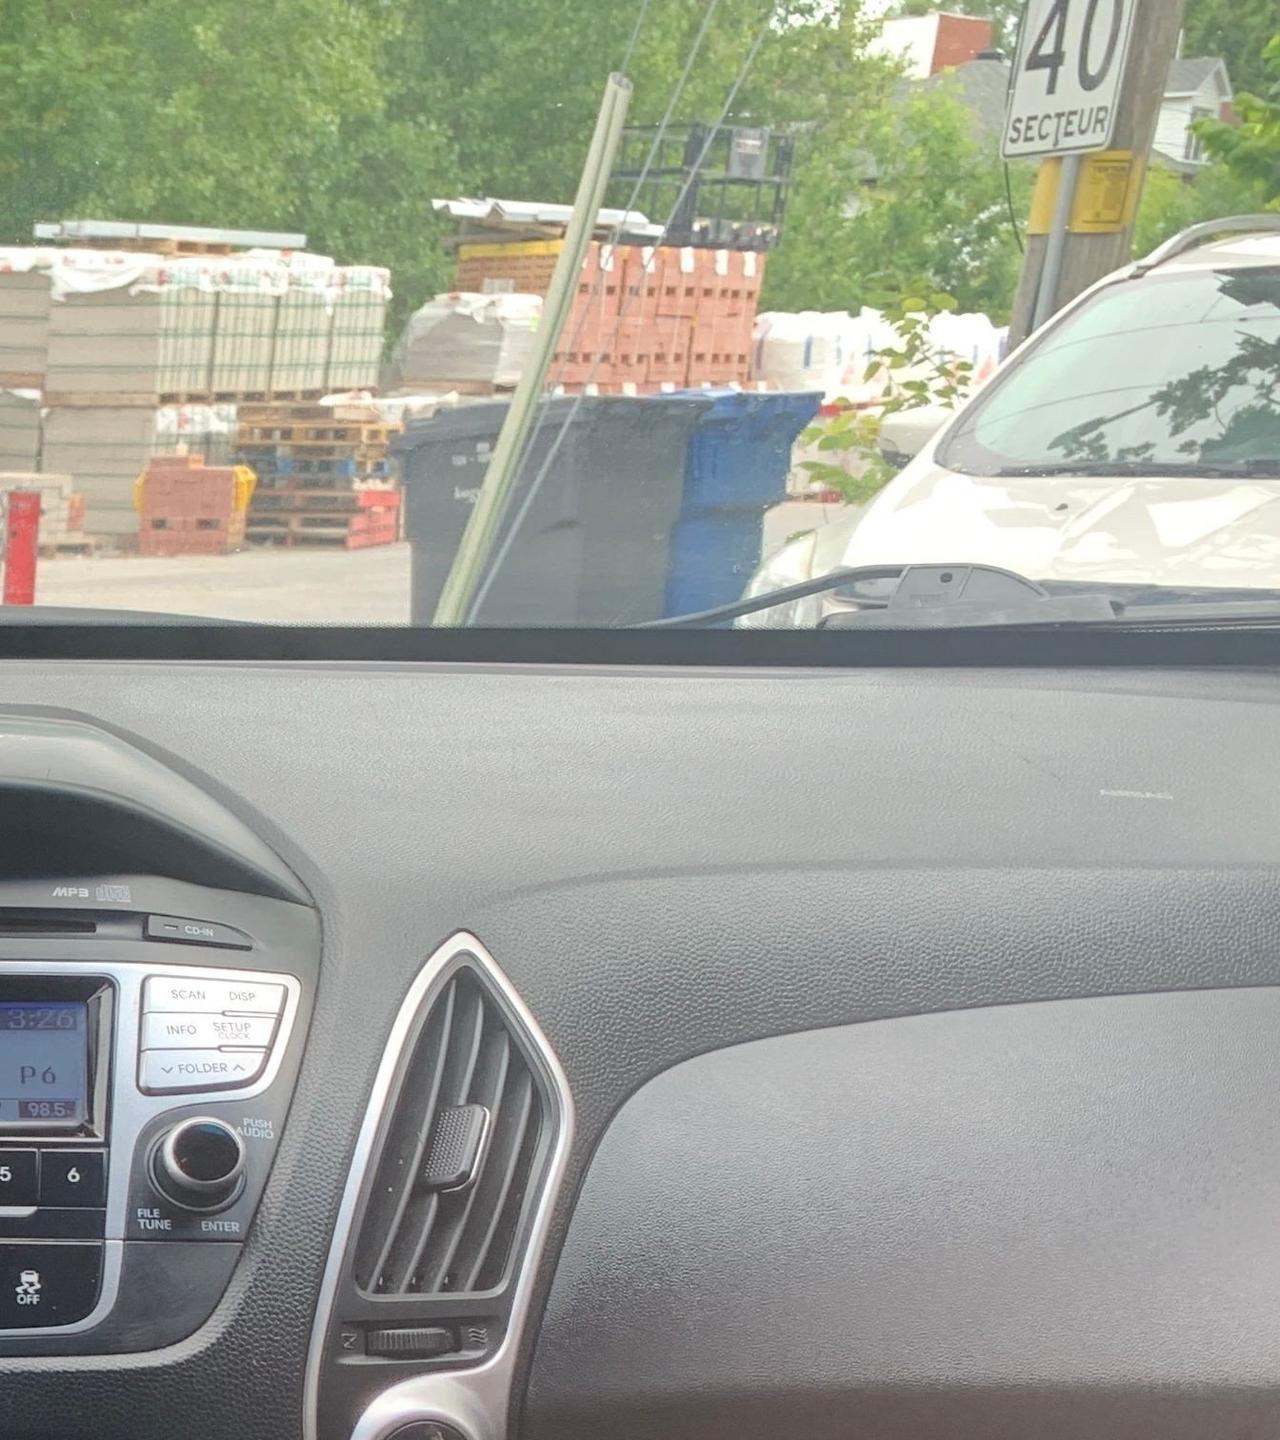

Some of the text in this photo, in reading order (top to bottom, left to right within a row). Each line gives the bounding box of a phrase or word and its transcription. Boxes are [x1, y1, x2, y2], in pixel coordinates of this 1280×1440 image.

[1024, 0, 1125, 95] 40
[1009, 106, 1109, 147] SECTEUR
[52, 887, 89, 897] MP3
[185, 926, 214, 936] CD-IN
[171, 990, 206, 1000] SCAN
[229, 991, 255, 1001] DISP
[8, 1008, 74, 1029] 3:26
[167, 1025, 197, 1035] INFO
[213, 1023, 251, 1032] SETUP
[218, 1032, 250, 1040] CLOCK
[178, 1063, 228, 1073] FOLDER
[28, 1102, 65, 1117] 98.5
[243, 1118, 273, 1129] PUSH
[236, 1127, 274, 1139] AUDIO
[0, 1167, 12, 1182] 5
[67, 1168, 80, 1183] 6
[137, 1208, 160, 1218] FILE
[138, 1219, 172, 1230] TUNE
[201, 1221, 240, 1232] ENTER
[17, 1294, 40, 1305] OFF
